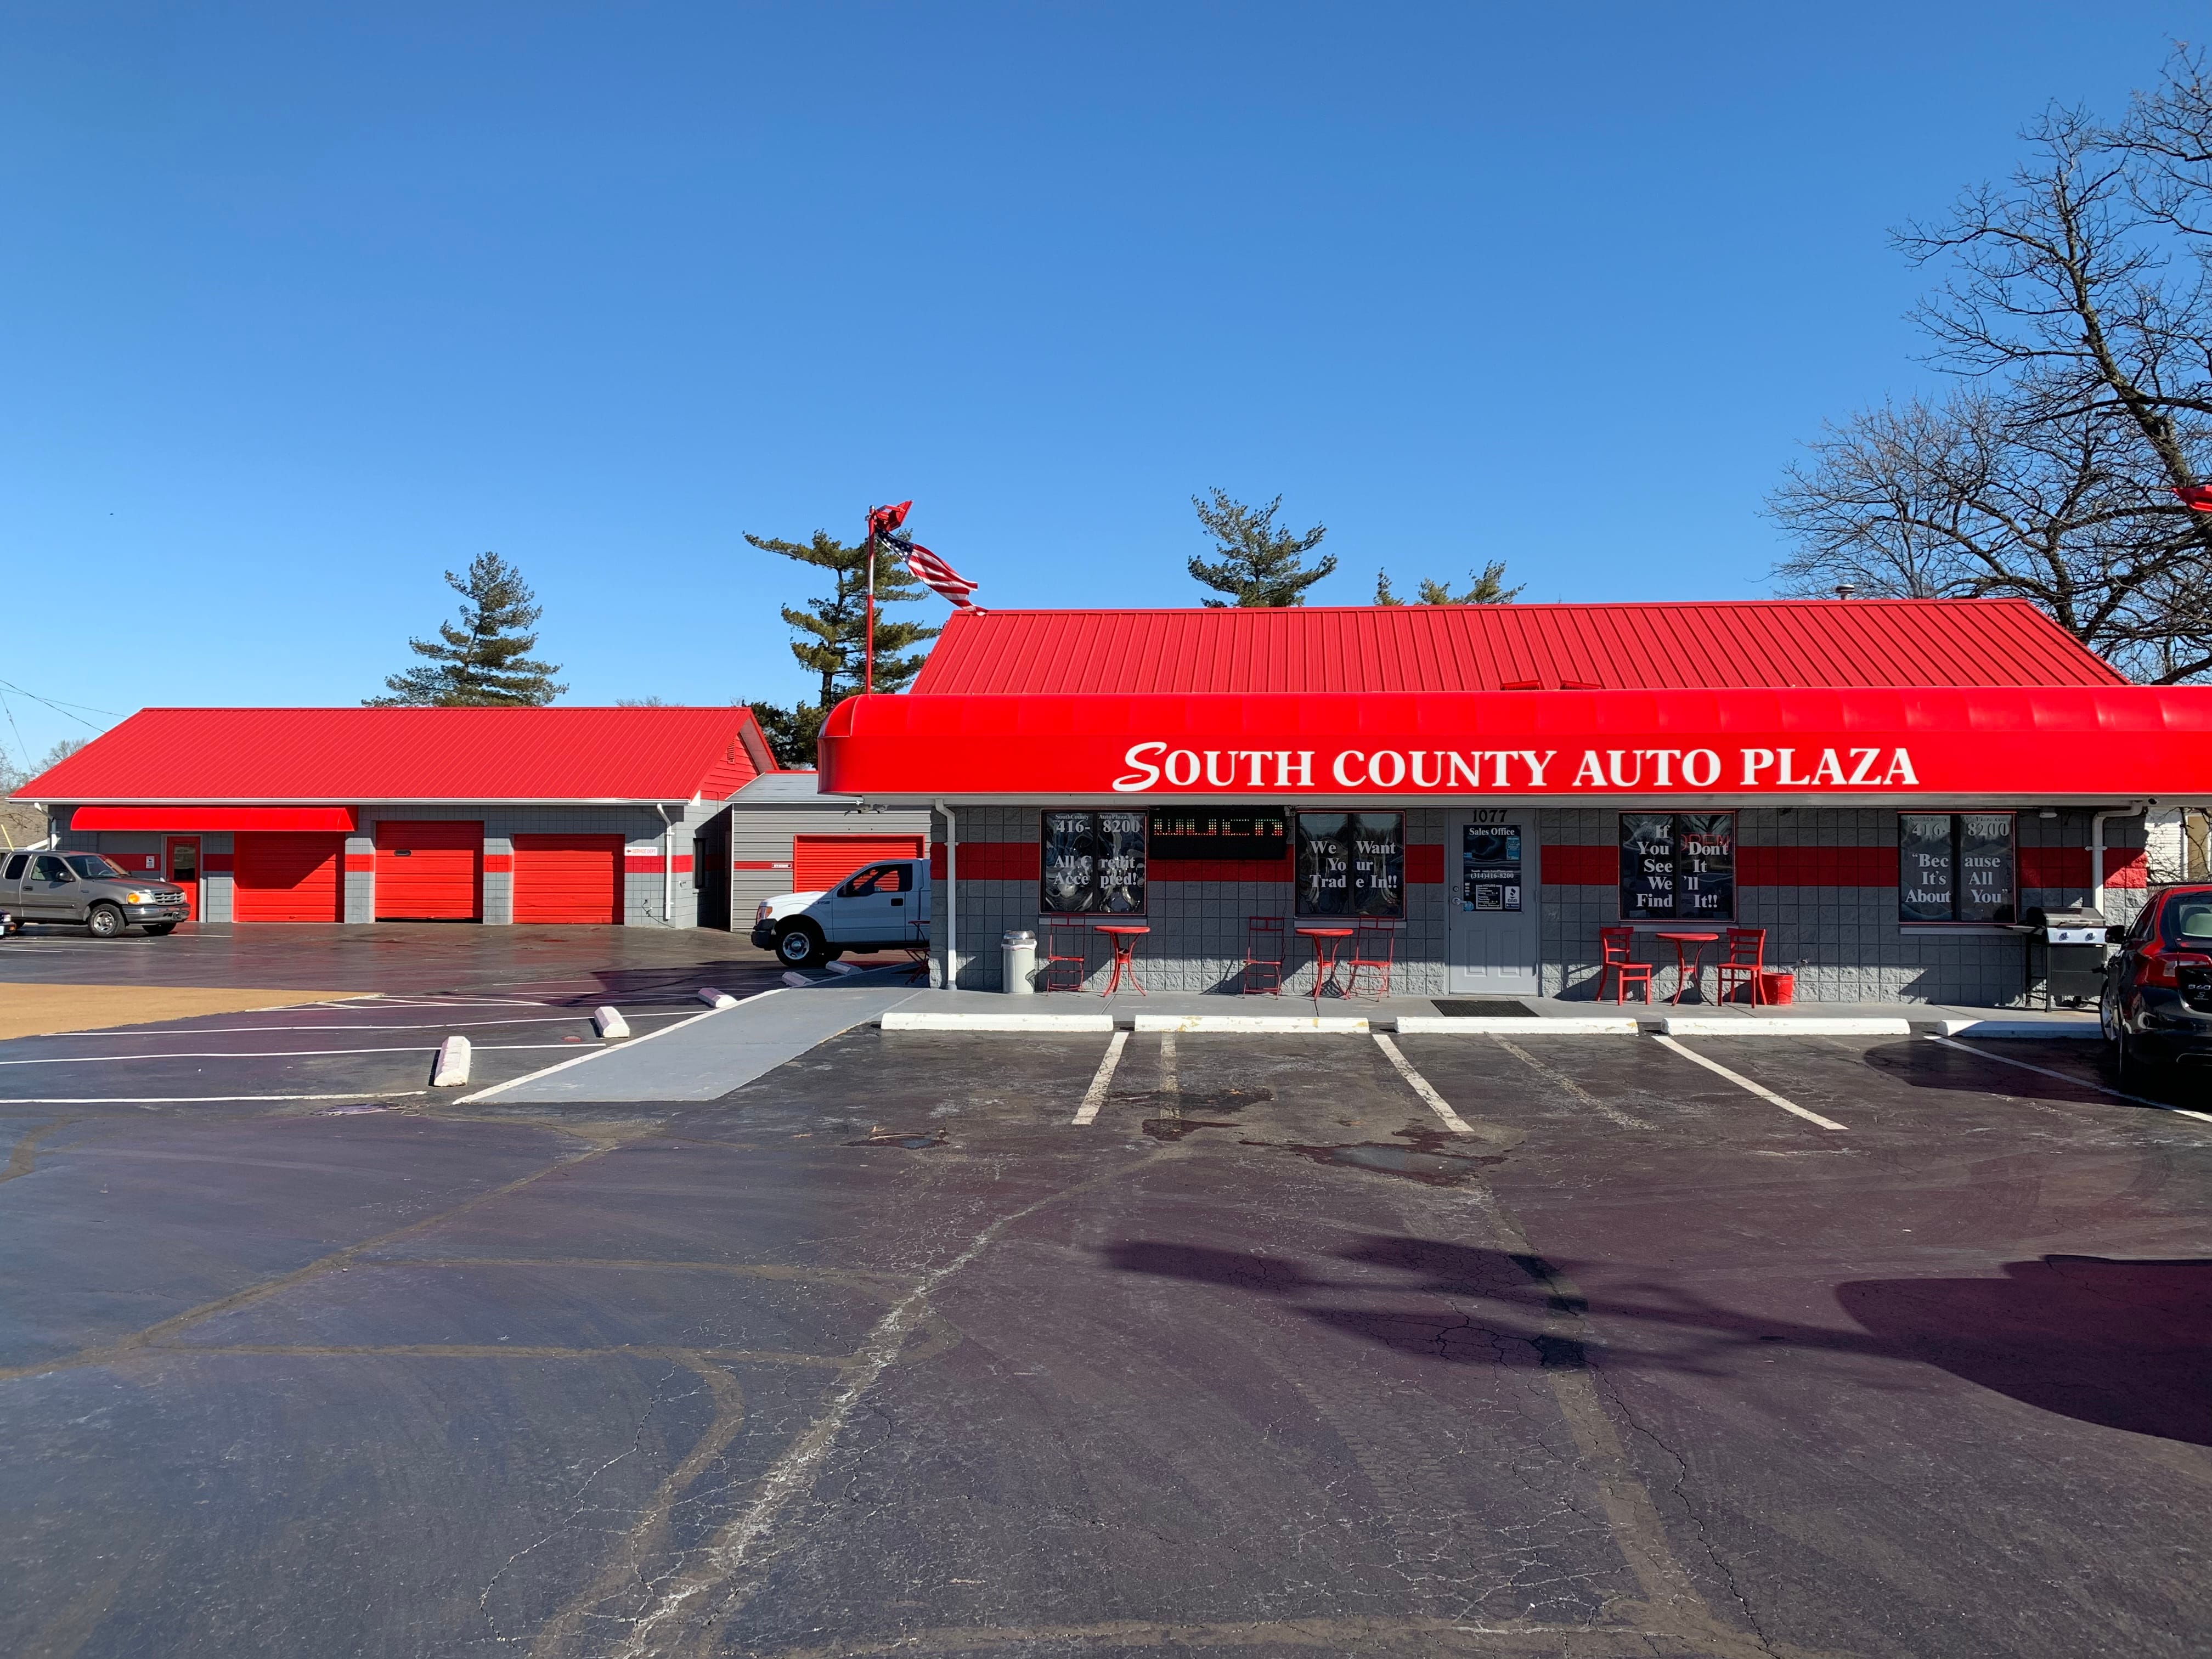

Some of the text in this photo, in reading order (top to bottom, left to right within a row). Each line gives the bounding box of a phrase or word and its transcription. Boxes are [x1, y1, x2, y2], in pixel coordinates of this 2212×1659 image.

[1113, 742, 1920, 792] SOUTH COUNTY AUTO PLAZA
[1473, 809, 1508, 823] 1077
[1057, 820, 1091, 833] 416-
[1103, 820, 1141, 833] 8200
[1655, 825, 1671, 838] If
[1967, 822, 2010, 836] 8200
[1310, 840, 1396, 854] We Want
[1637, 841, 1728, 855] You Don't
[1053, 855, 1074, 868] All
[1644, 859, 1707, 873] See It
[1370, 875, 1397, 888] In!!
[1922, 871, 1993, 885] It's All
[1636, 893, 1718, 908] Find It!!
[1905, 889, 1951, 903] About
